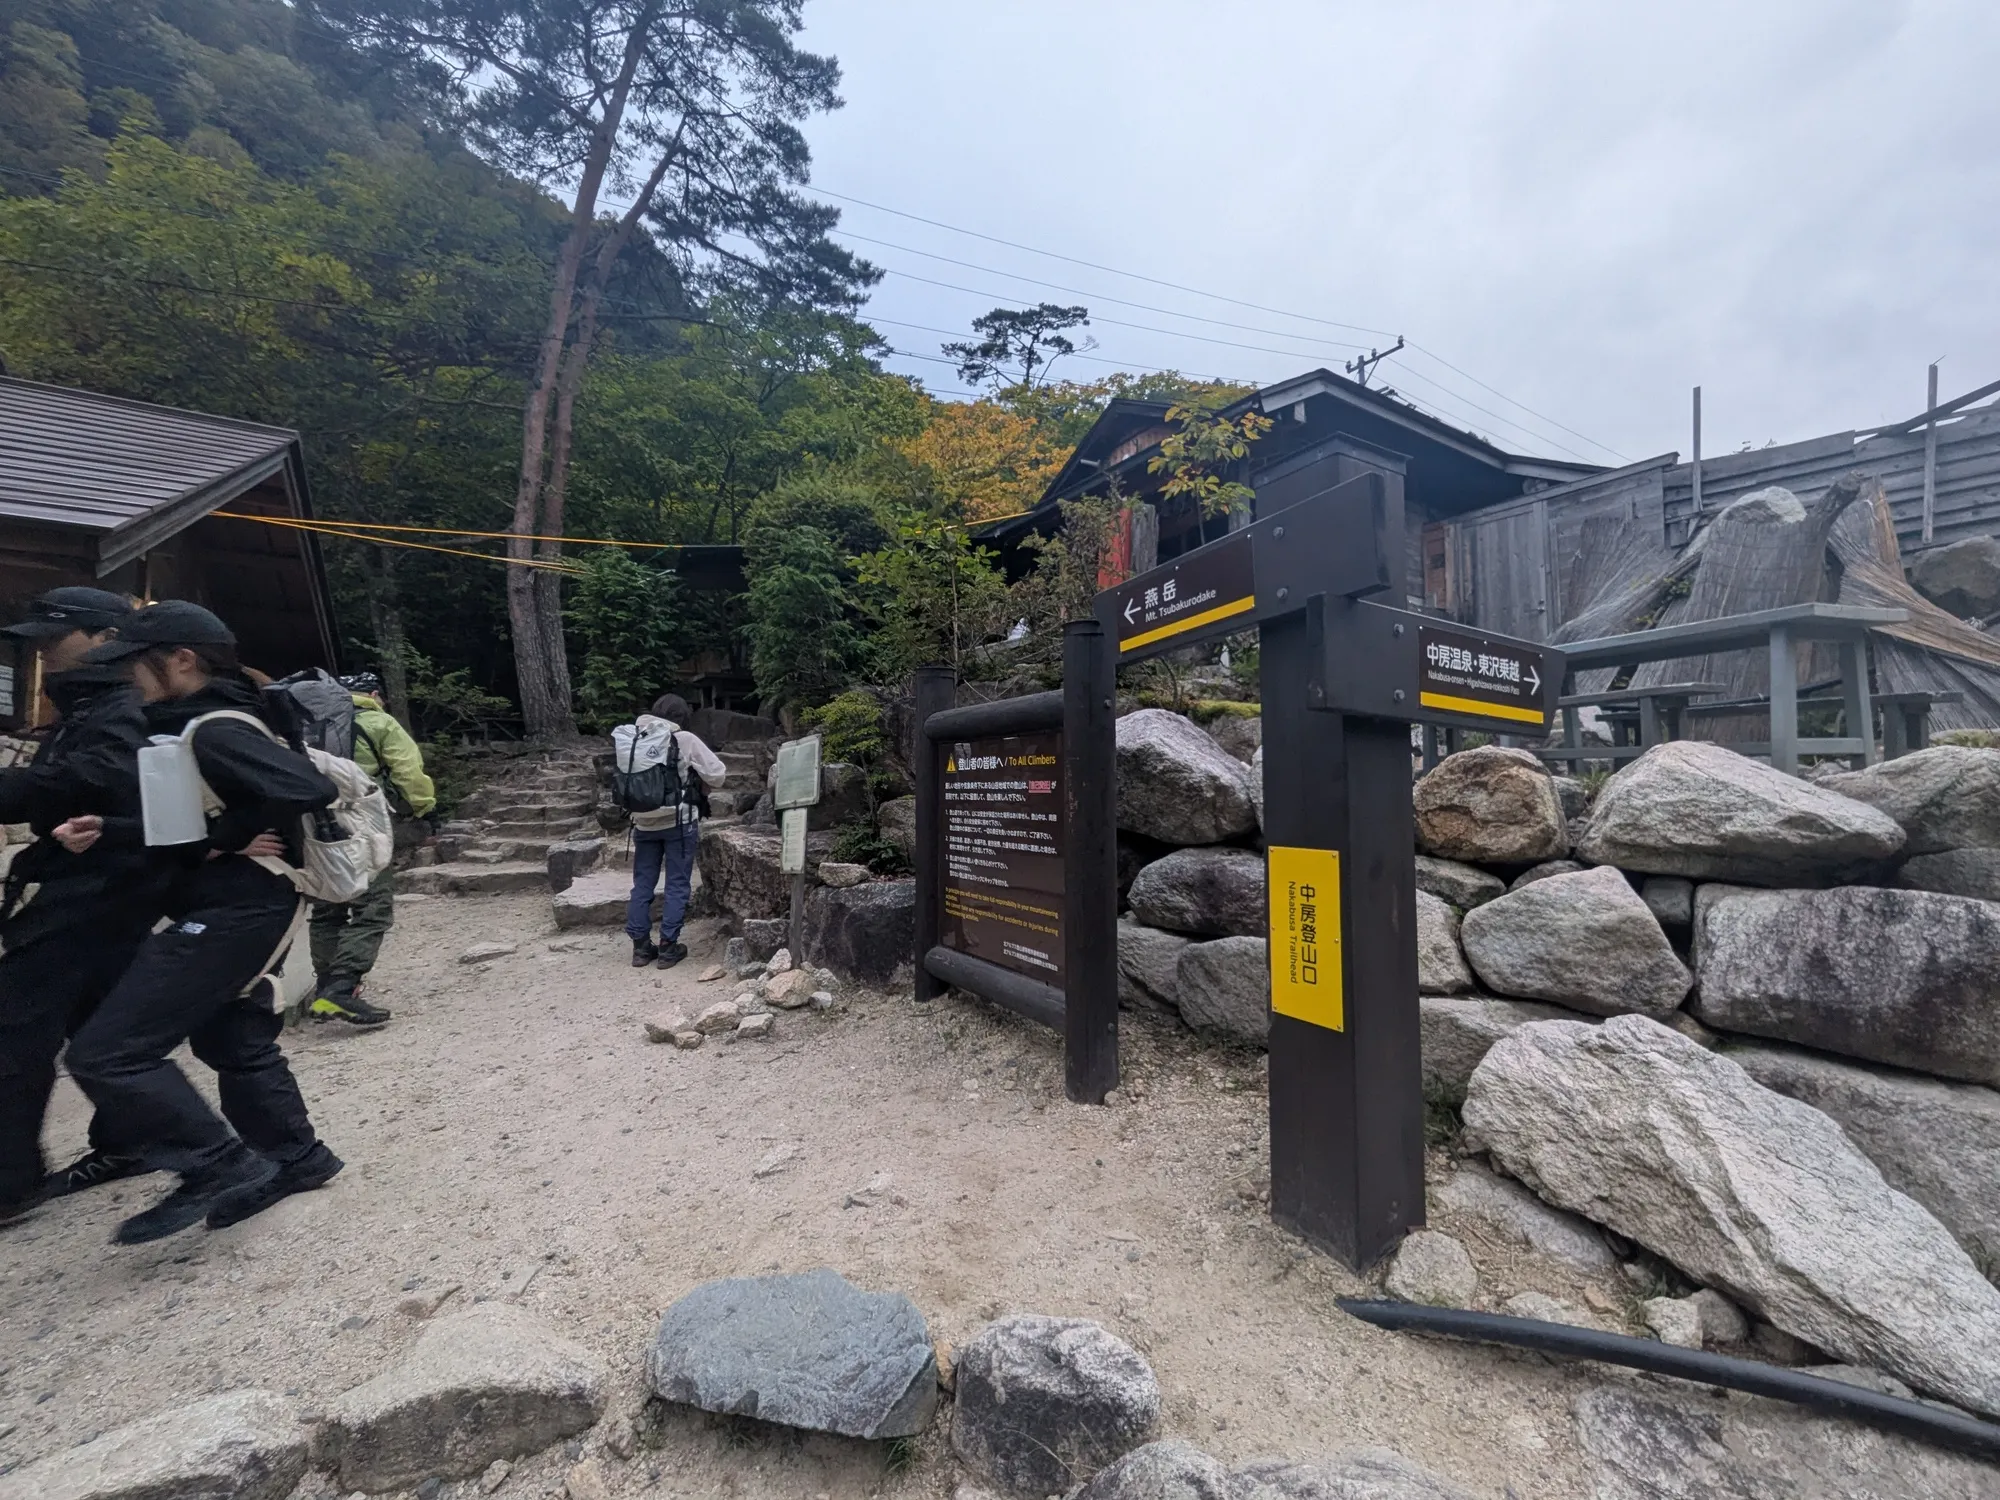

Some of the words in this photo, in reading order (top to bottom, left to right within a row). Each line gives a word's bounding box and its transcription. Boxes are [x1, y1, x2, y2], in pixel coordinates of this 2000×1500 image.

[1144, 579, 1176, 610] 燕岳
[1145, 611, 1158, 623] Mt.
[1159, 588, 1217, 619] Tsubakurodake
[1426, 642, 1520, 683] 中房温泉・東沢乗越
[958, 756, 1004, 771] 登山者の皆様へ
[1009, 757, 1017, 767] To
[1017, 756, 1027, 766] All
[1027, 755, 1056, 766] Climbers
[1288, 881, 1297, 932] Nakabusa
[1299, 883, 1317, 985] 中房登山口
[1288, 935, 1298, 984] Trailhead
